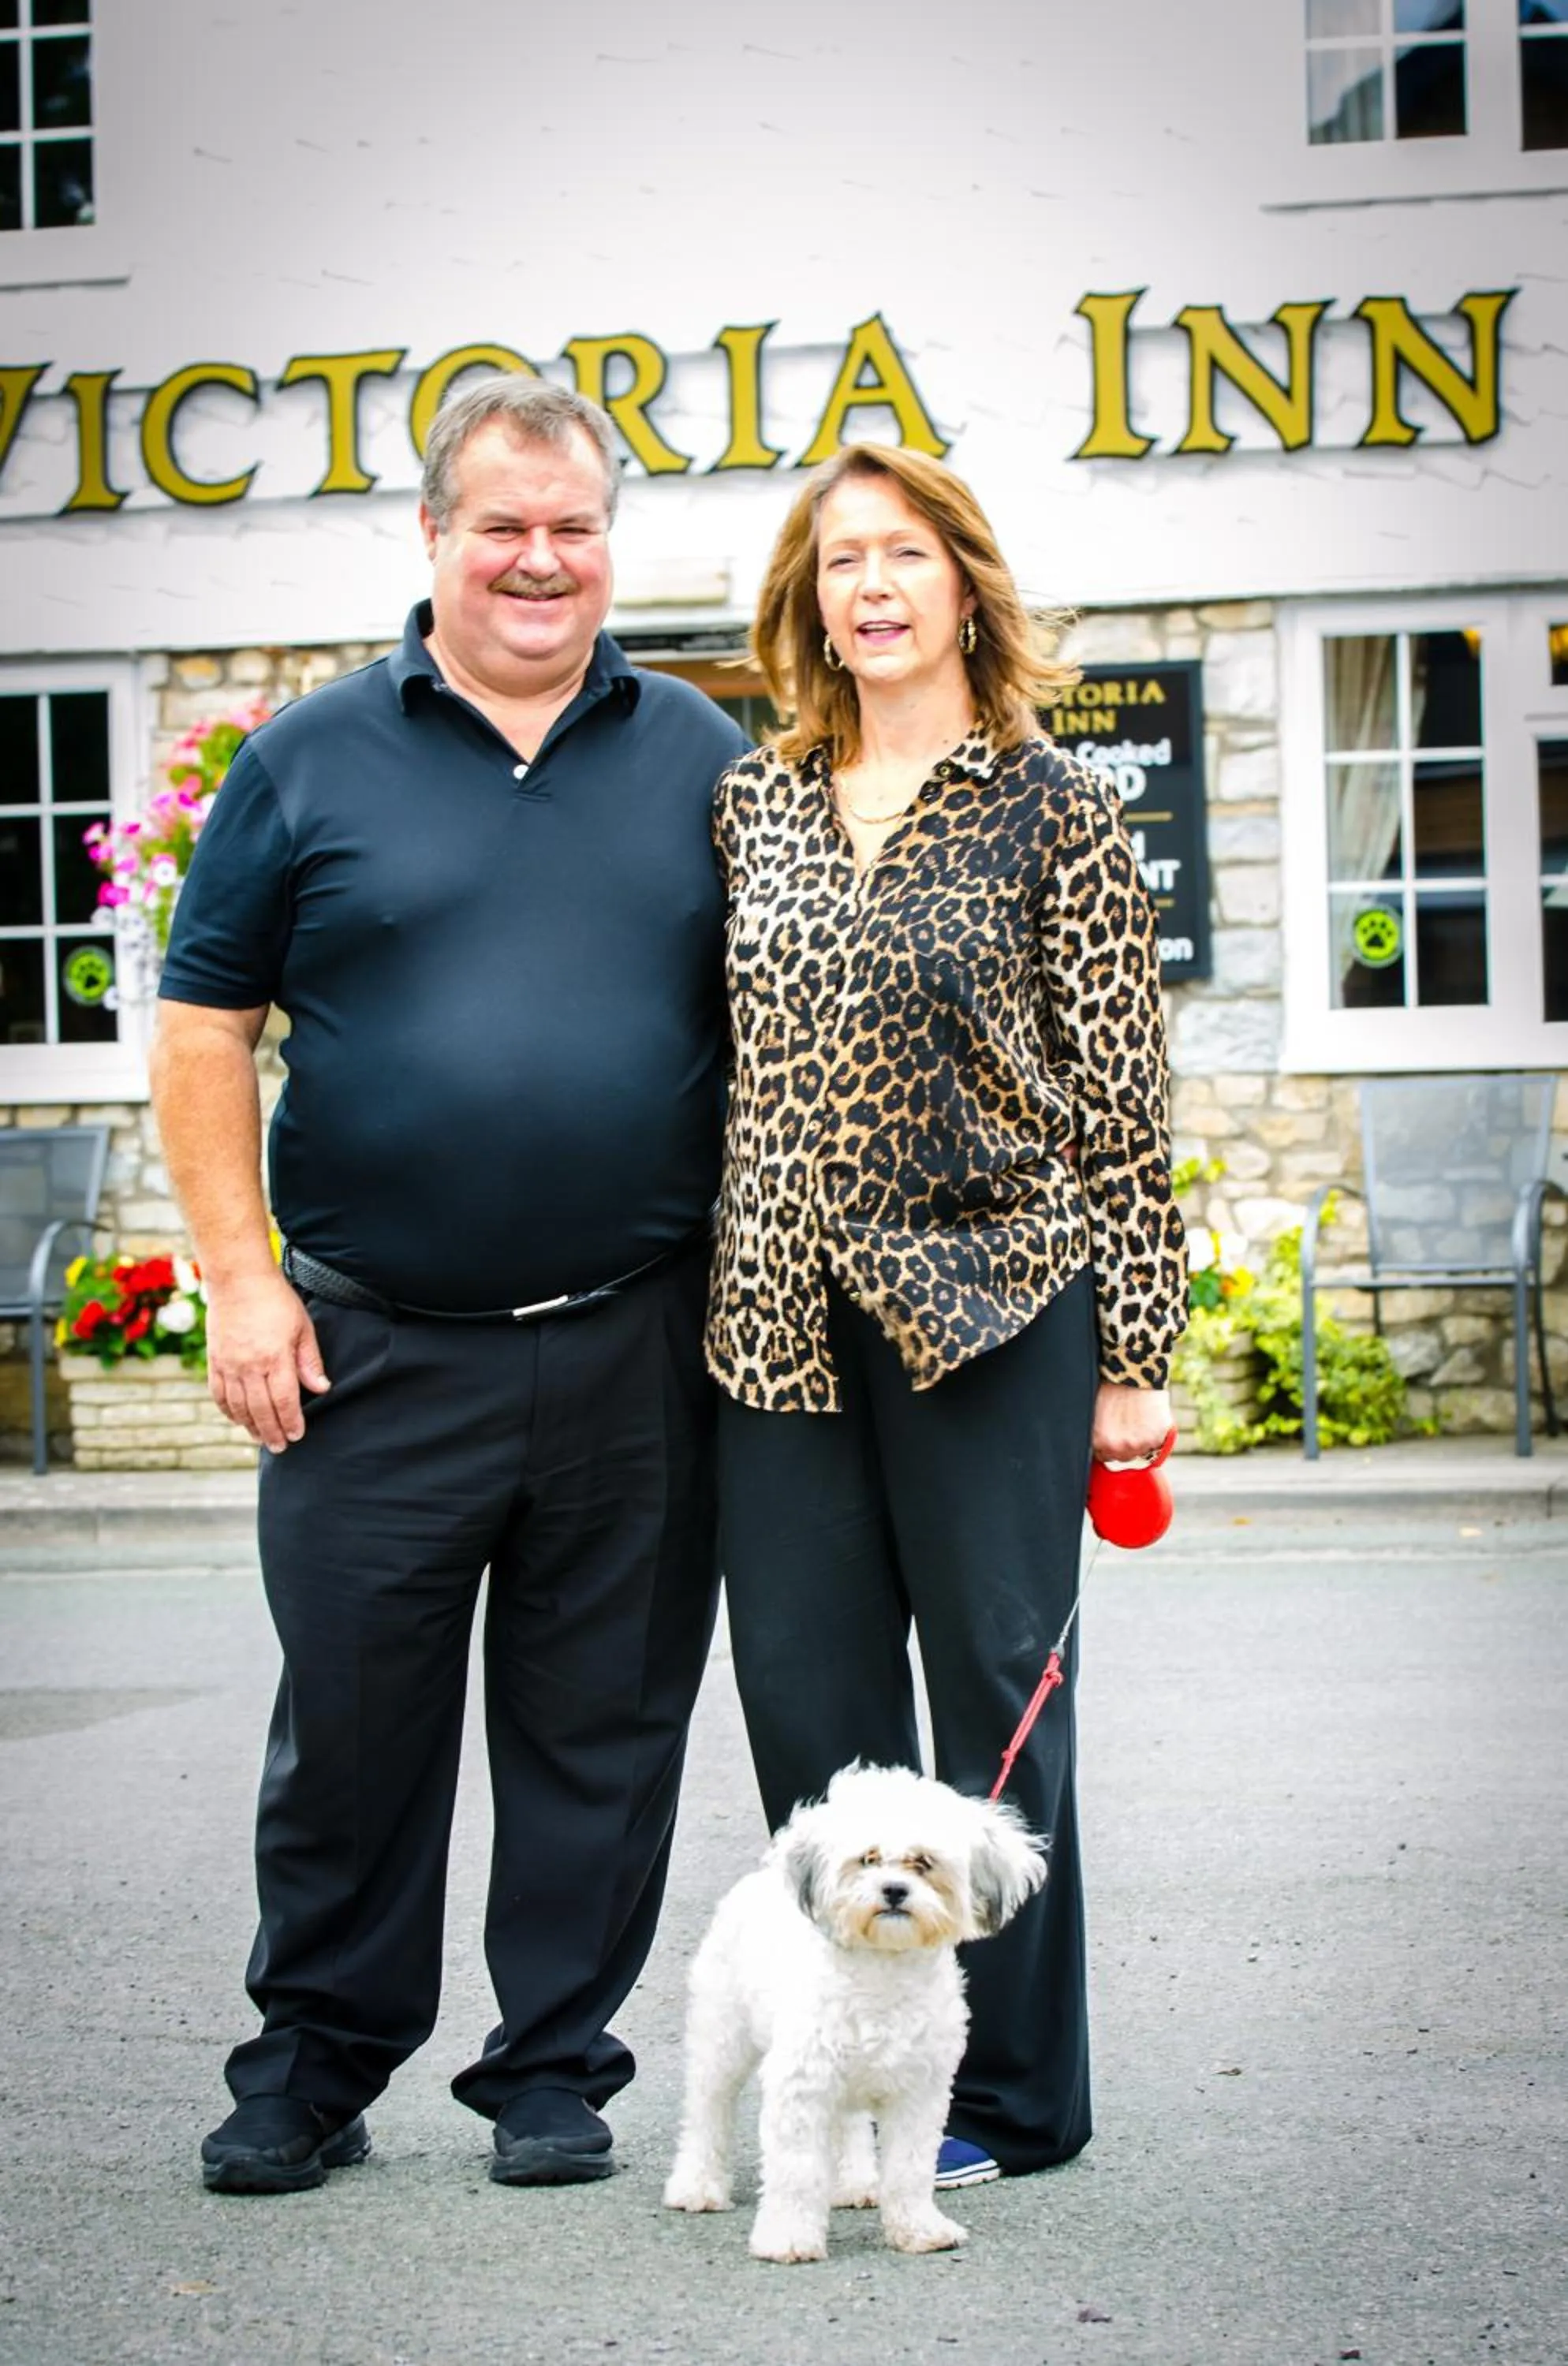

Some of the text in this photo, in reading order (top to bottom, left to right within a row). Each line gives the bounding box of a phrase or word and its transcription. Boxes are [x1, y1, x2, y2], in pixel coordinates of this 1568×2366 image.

[1066, 287, 1521, 461] INN
[1036, 679, 1166, 708] TORIA
[1051, 707, 1117, 736] INN
[1076, 737, 1172, 767] Cooked
